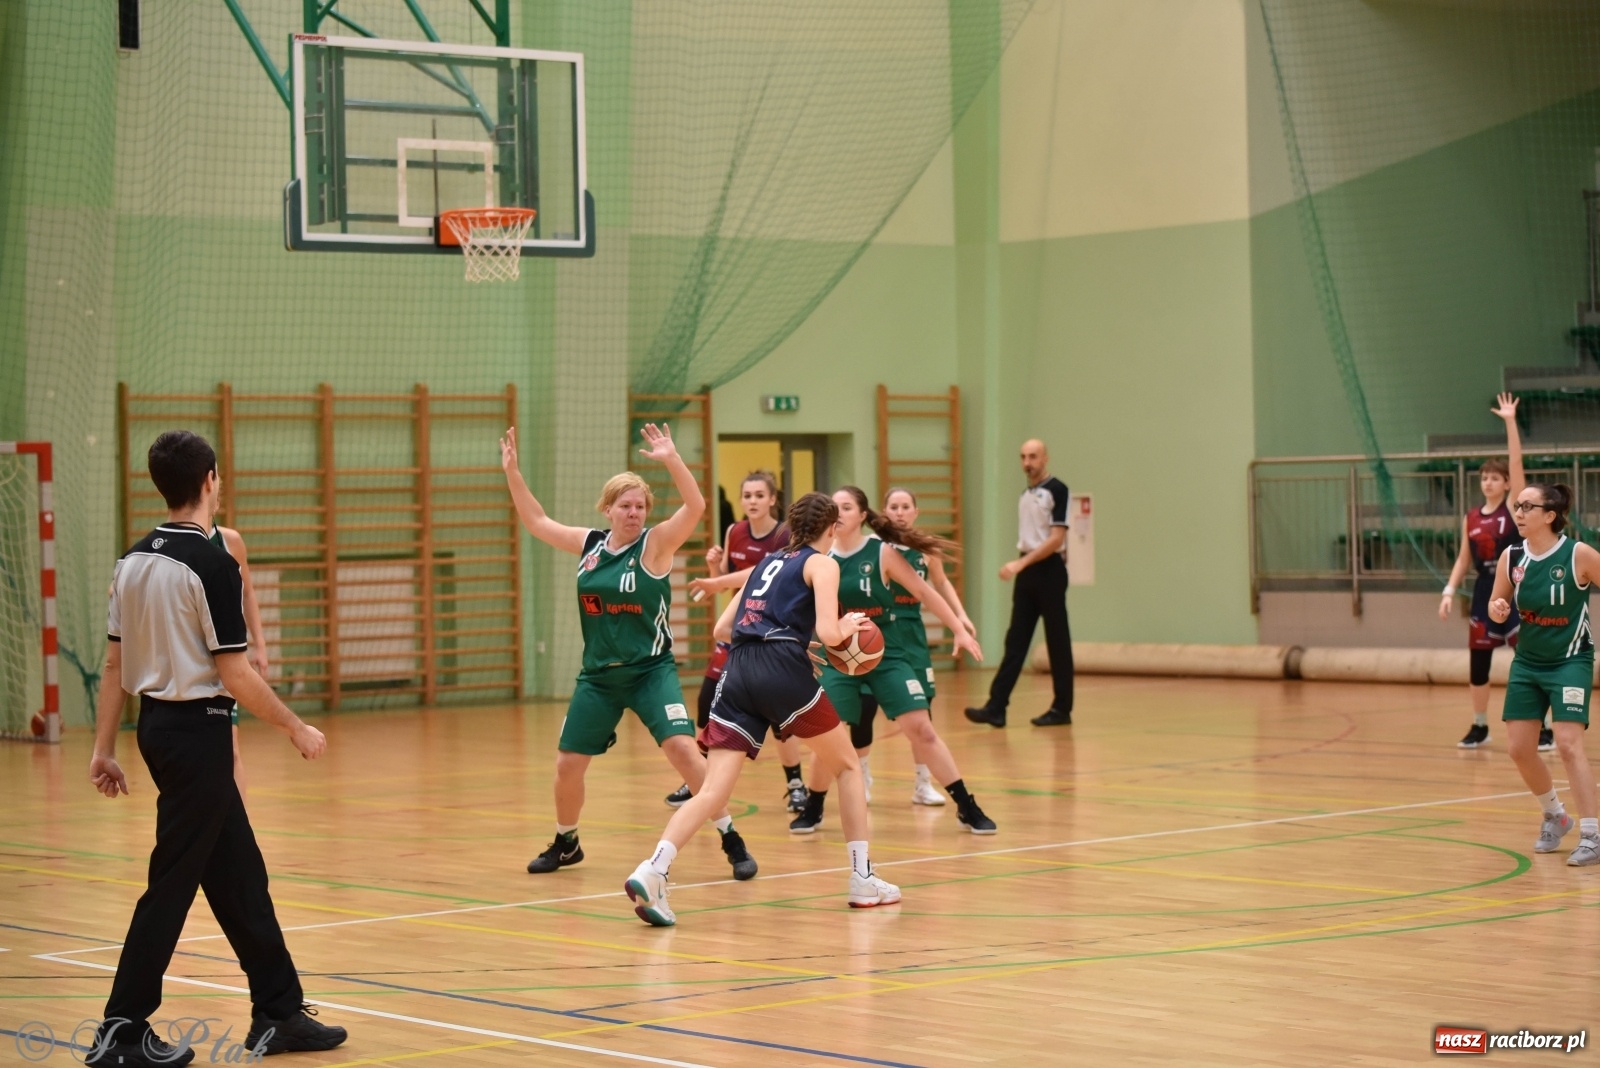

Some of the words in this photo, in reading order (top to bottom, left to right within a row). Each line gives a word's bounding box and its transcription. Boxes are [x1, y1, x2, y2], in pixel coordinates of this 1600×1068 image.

[1497, 516, 1506, 534] 7
[619, 571, 636, 593] 10
[751, 559, 784, 596] 9
[859, 577, 871, 597] 4
[1550, 584, 1565, 606] 11
[606, 603, 642, 614] KAMAN
[1535, 616, 1569, 626] KAMAN
[206, 706, 229, 716] SPALDING
